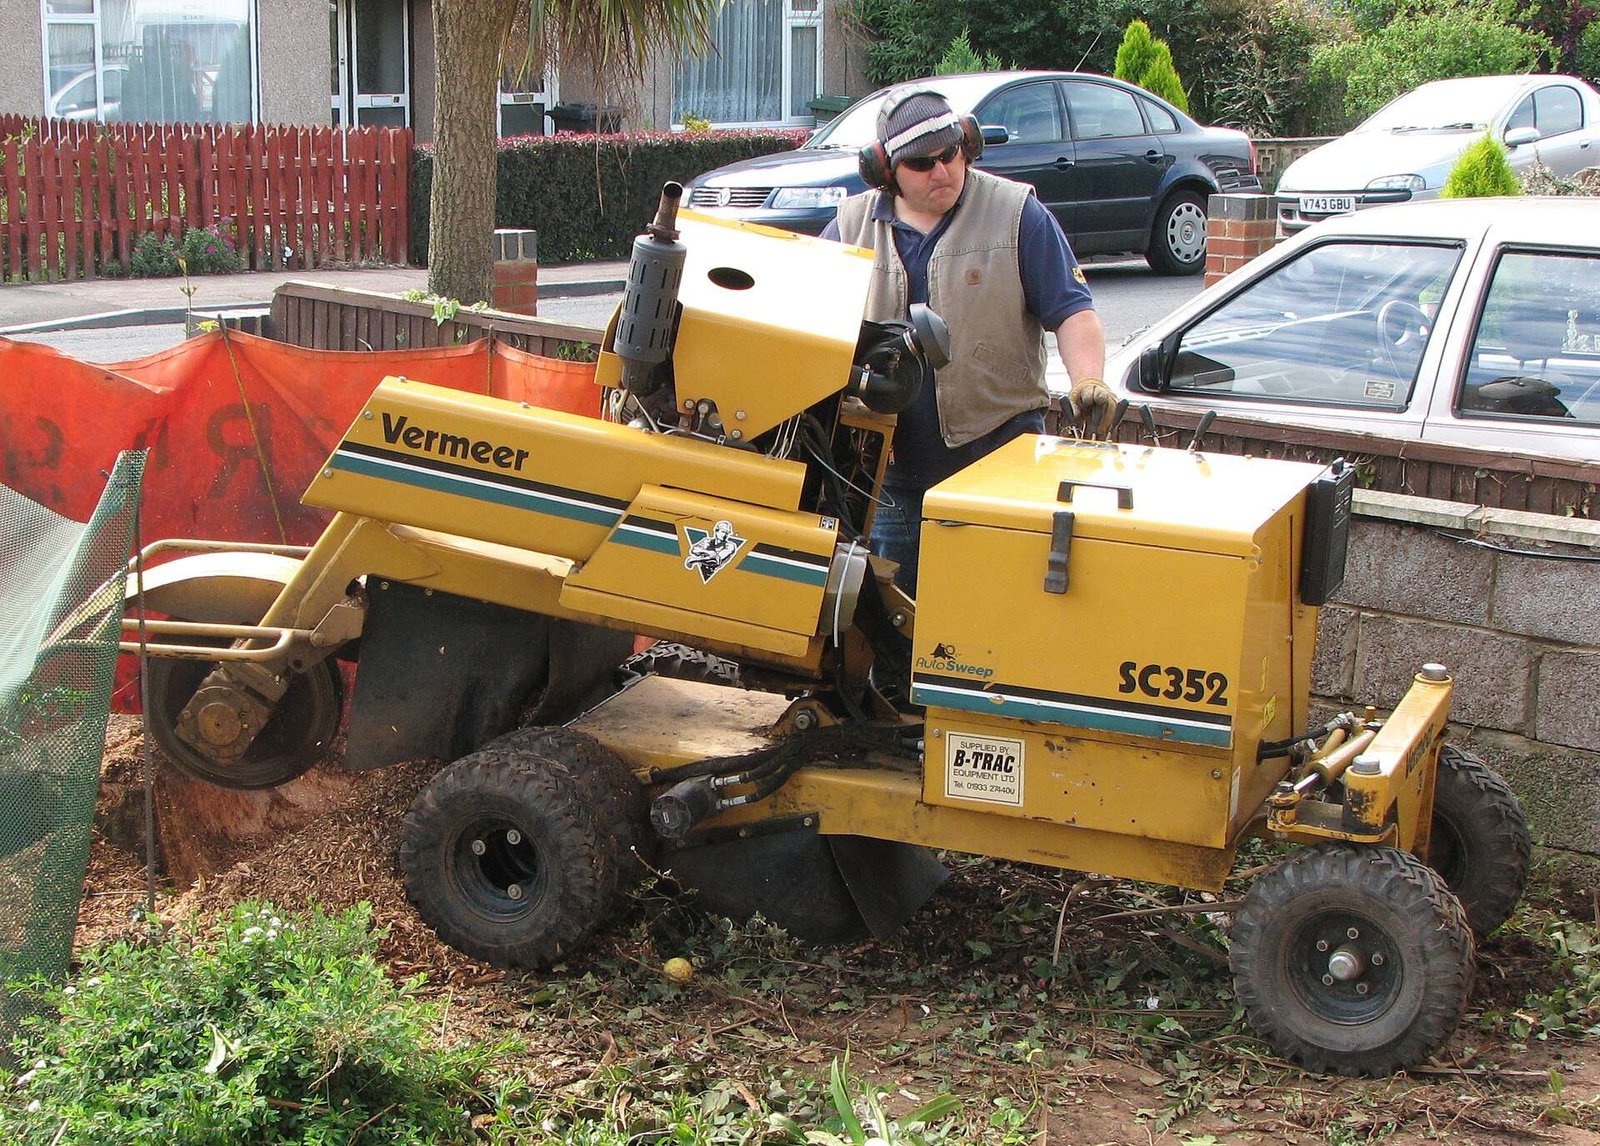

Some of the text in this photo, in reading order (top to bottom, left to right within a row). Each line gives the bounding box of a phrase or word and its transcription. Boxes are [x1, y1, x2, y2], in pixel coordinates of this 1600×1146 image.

[1303, 198, 1351, 210] V743 GBU
[382, 412, 529, 471] Vermeer
[915, 656, 993, 678] AutoSweep
[1118, 661, 1228, 706] SC352
[960, 741, 1010, 755] SUPPLIED BY
[953, 749, 1015, 773] B-TRAC
[953, 768, 1015, 783] EQUIPMENT LTD
